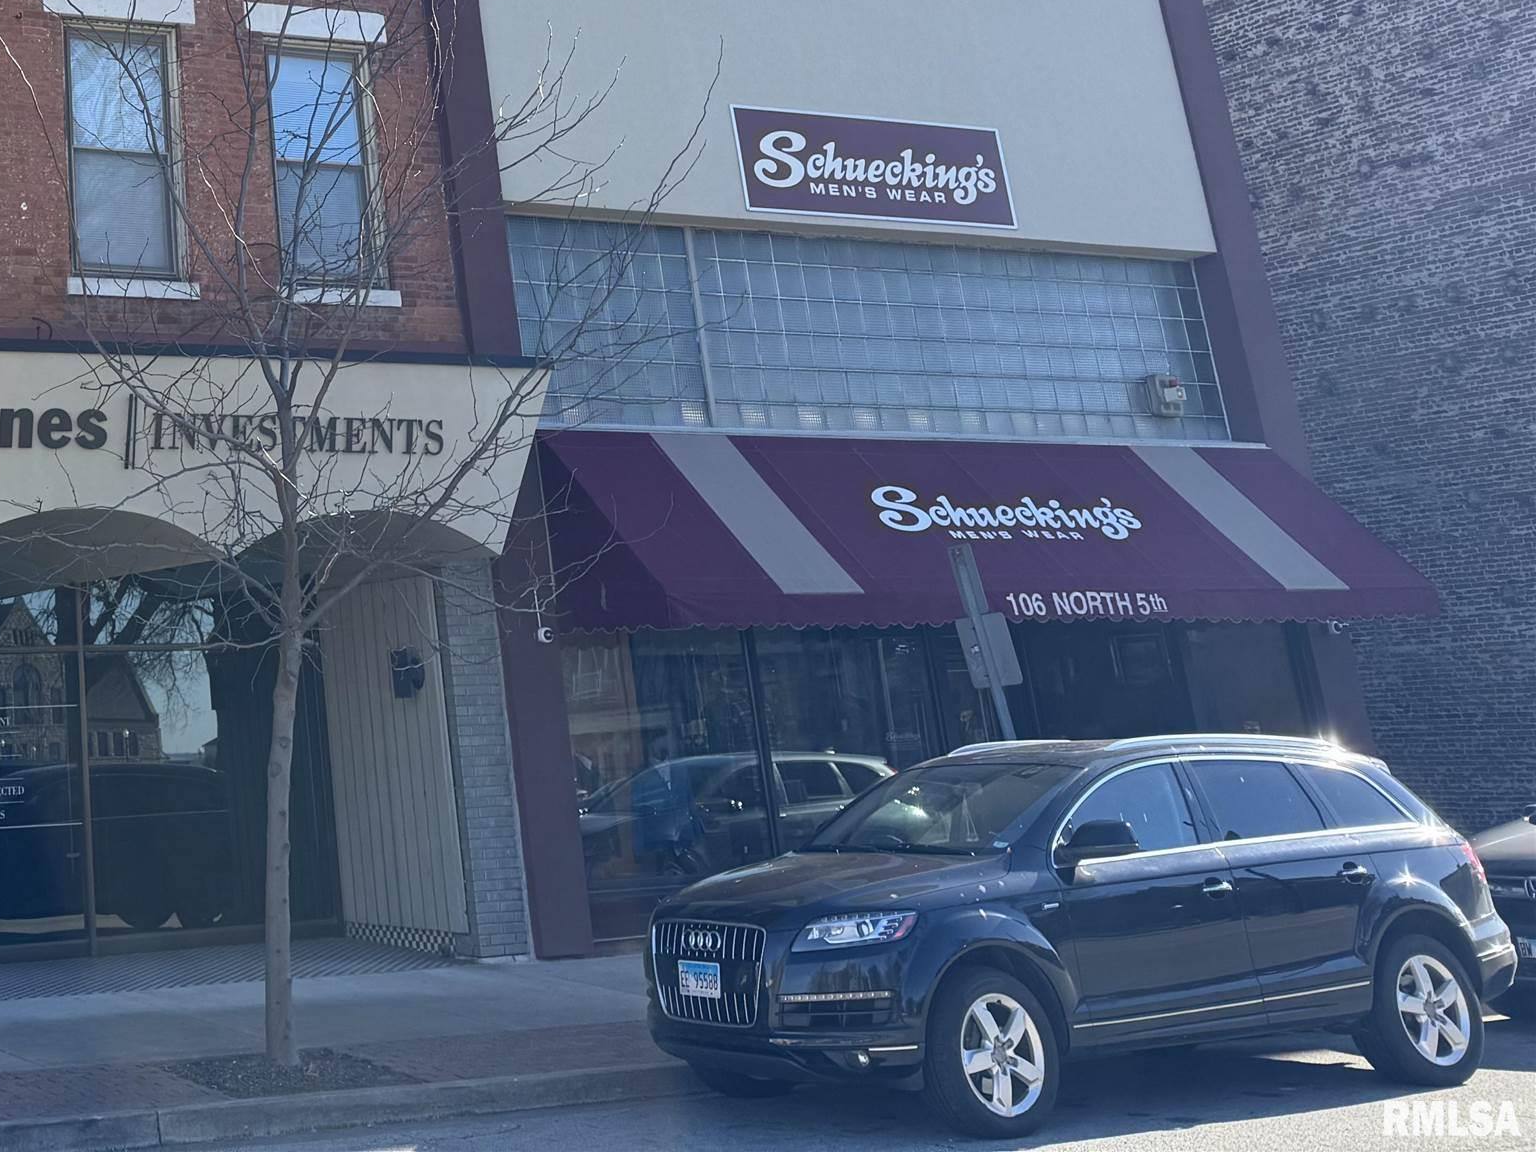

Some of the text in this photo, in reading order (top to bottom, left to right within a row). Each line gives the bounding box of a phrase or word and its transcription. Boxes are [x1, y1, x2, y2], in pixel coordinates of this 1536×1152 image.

[753, 130, 997, 205] Schuecking's
[810, 182, 947, 203] MEN'S WEAR
[871, 485, 1142, 540] Schuecking's
[948, 529, 1085, 541] MEN'S WEAR
[1006, 591, 1169, 616] 106 NORTH 5th
